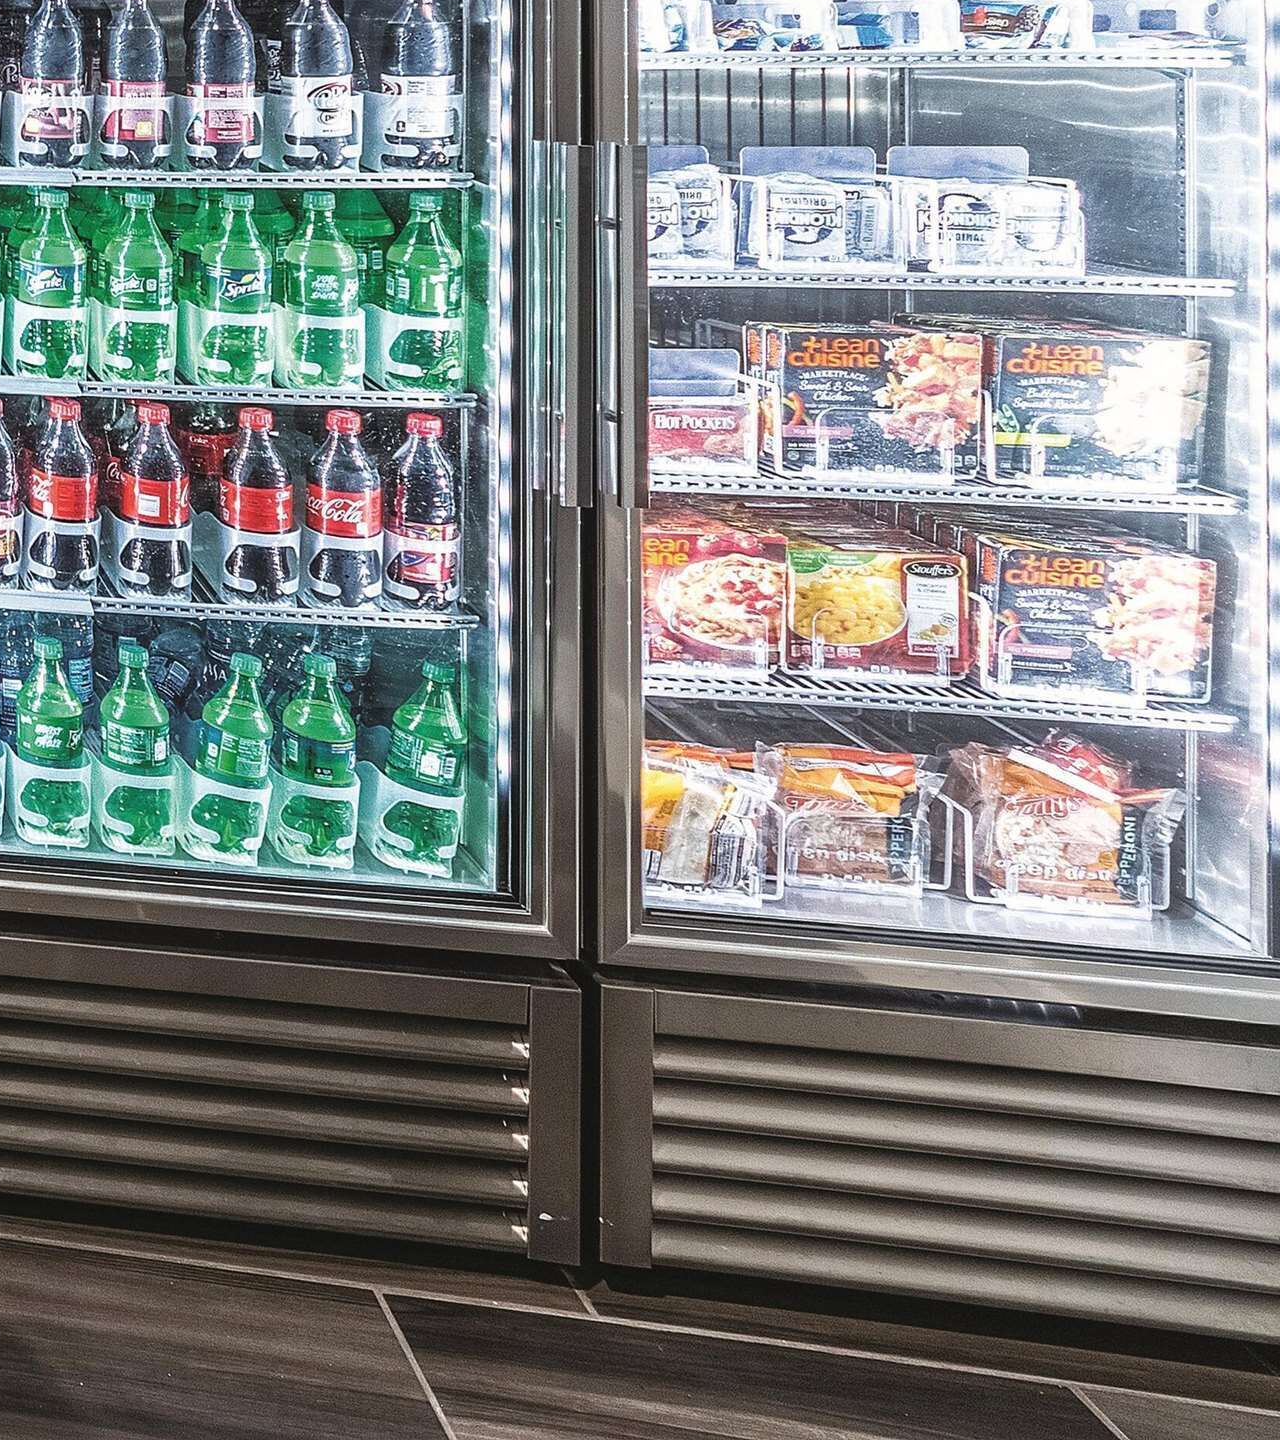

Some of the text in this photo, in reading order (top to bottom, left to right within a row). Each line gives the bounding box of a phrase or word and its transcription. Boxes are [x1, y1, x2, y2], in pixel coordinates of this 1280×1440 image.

[655, 415, 737, 432] HOT POCKETS
[645, 537, 690, 552] ean
[910, 563, 955, 577] Stouffer's
